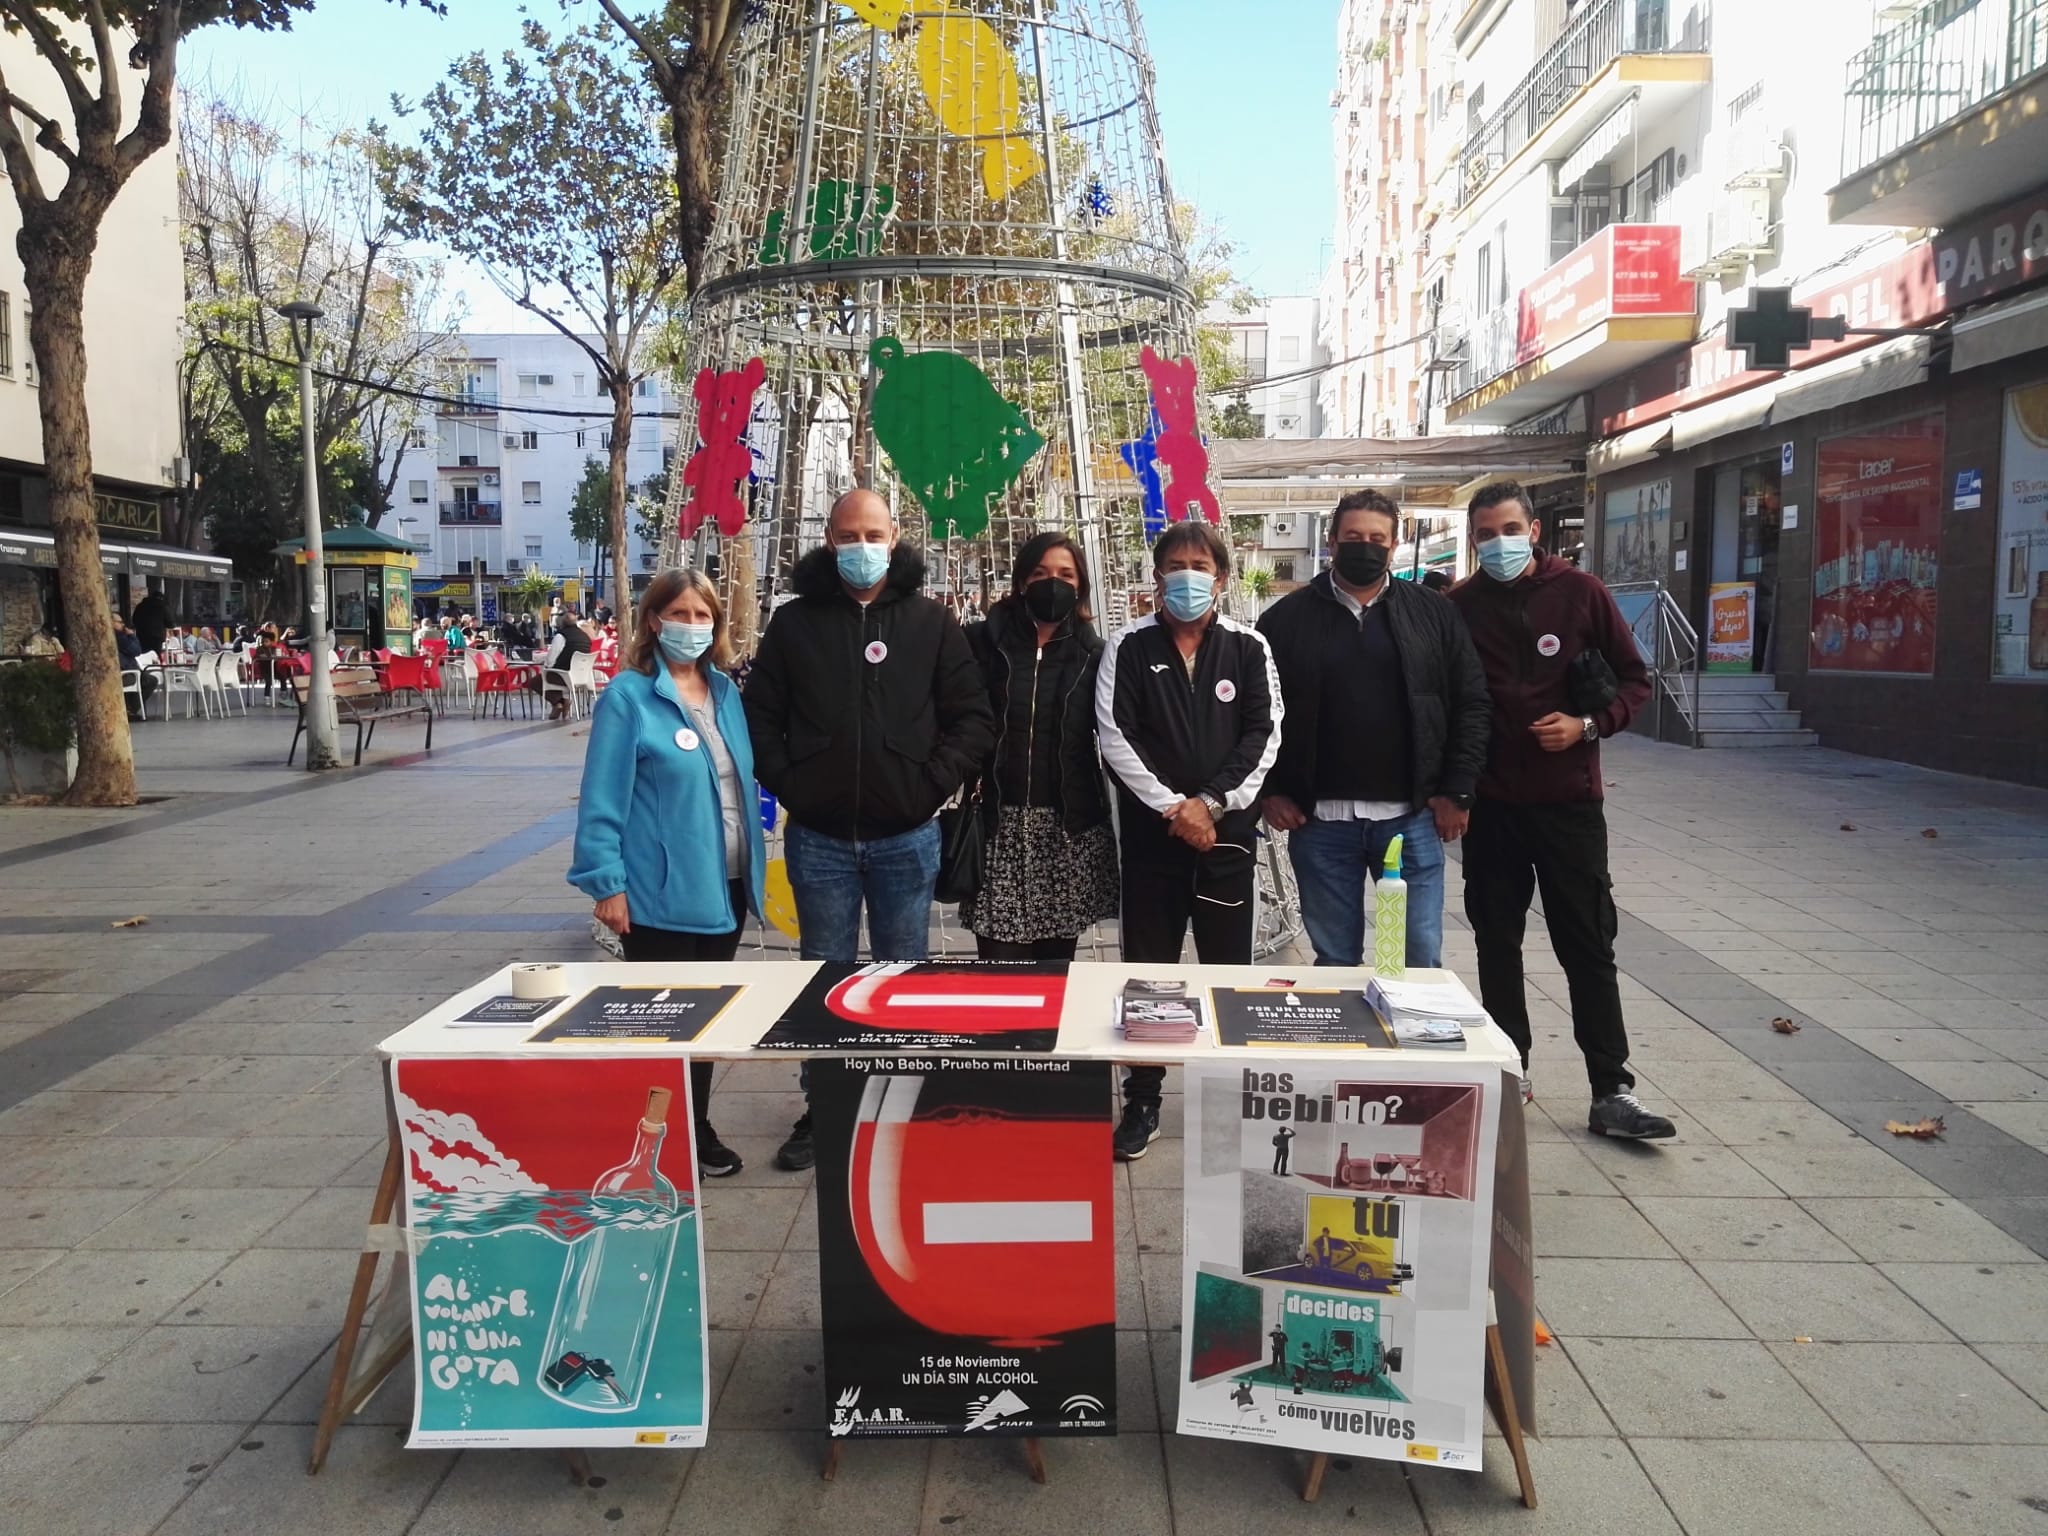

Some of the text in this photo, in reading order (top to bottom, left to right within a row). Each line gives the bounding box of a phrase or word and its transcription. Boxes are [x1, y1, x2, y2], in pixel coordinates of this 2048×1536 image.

[1829, 277, 1890, 329] DEL
[1859, 457, 1895, 480] Lacer
[845, 1058, 1070, 1072] Hoy No Bebo. Pruebo mi Libertad
[1242, 1068, 1294, 1093] has
[1242, 1092, 1403, 1126] bebido?
[1353, 1195, 1401, 1239] tú
[424, 1273, 471, 1301] AL
[1286, 1294, 1375, 1323] decides
[465, 1327, 522, 1351] UNA
[430, 1354, 520, 1390] GOTA
[920, 1355, 1020, 1368] 15 de Noviembre
[902, 1370, 1039, 1385] UN DÍA SIN ALCOHOL
[834, 1407, 910, 1423] F.A.A.R.
[1278, 1403, 1416, 1441] cómo vuelves
